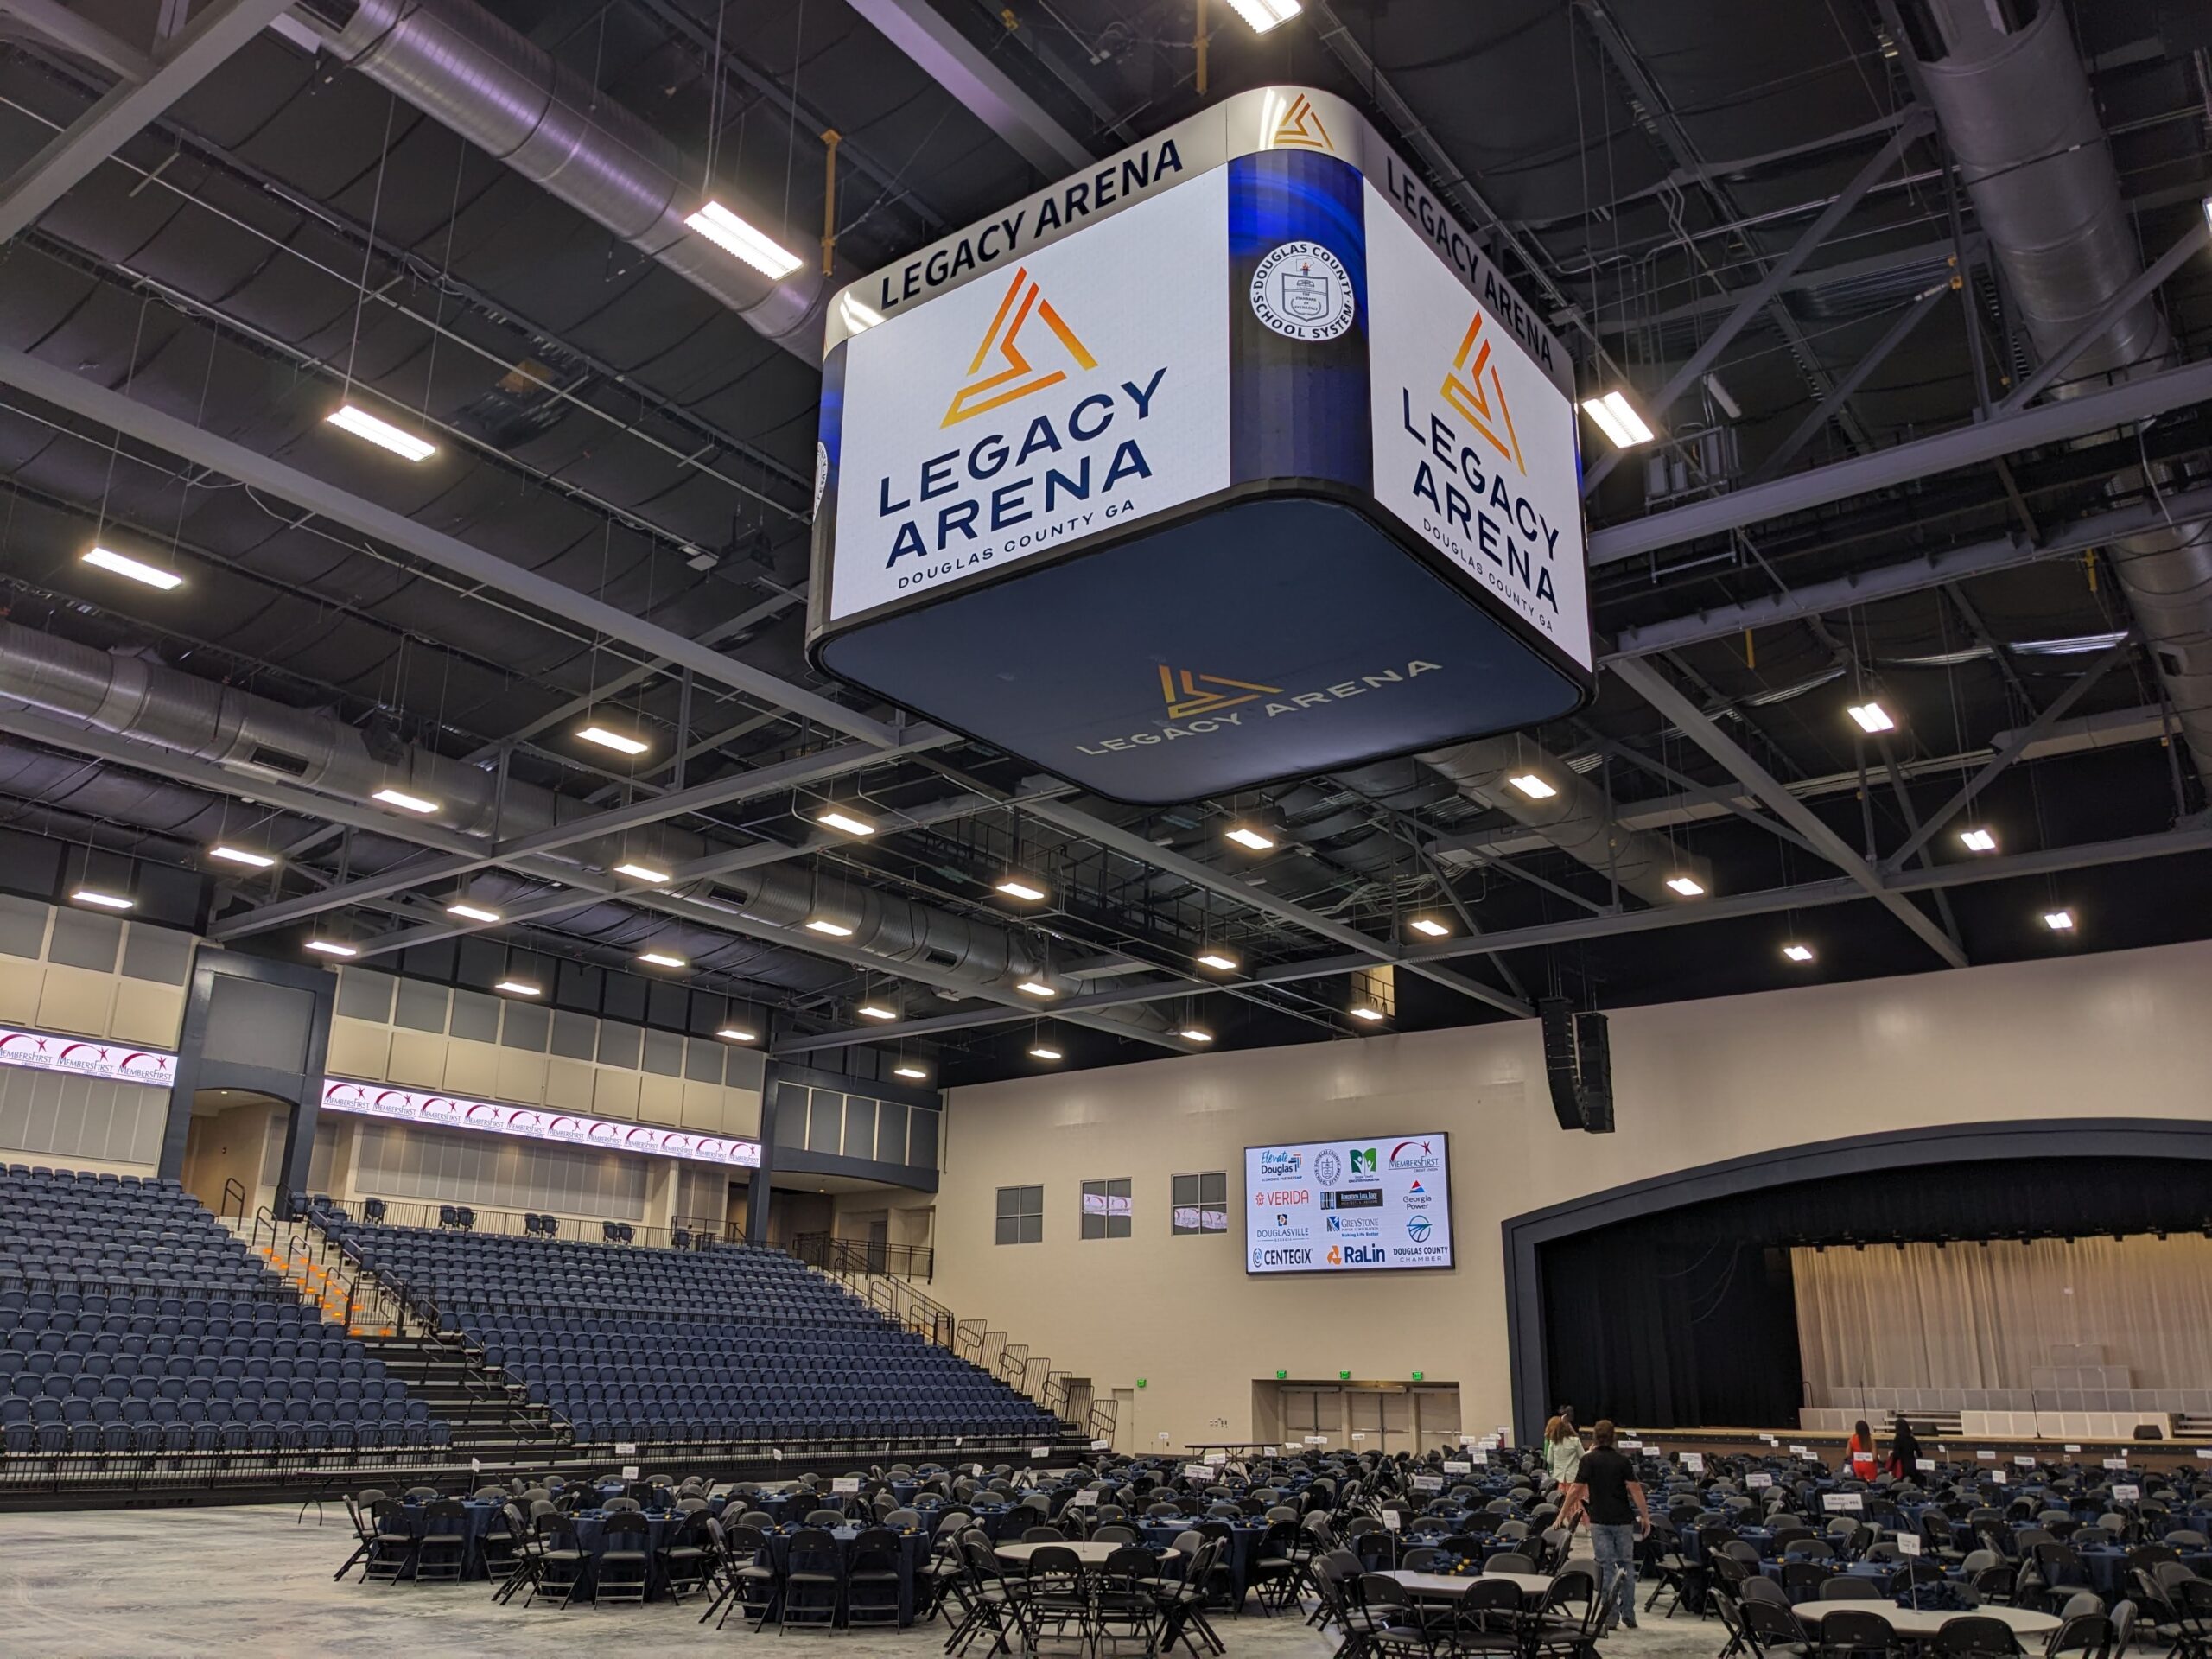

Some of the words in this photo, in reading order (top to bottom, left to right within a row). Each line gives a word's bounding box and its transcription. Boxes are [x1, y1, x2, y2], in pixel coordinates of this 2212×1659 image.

[880, 212, 1026, 311] LEGACY
[1033, 139, 1184, 238] ARENA
[1254, 244, 1307, 289] DOUGLAS
[1312, 247, 1351, 299] COUNTY
[1387, 156, 1478, 284] LEGACY
[1484, 270, 1554, 372] ARENA
[1253, 296, 1306, 337] SCHOOL
[1312, 304, 1352, 338] SYSTEM
[879, 366, 1167, 518] LEGACY
[1403, 386, 1559, 561] LEGACY
[886, 439, 1153, 569] ARENA
[898, 546, 994, 589] DOUGLAS
[1004, 512, 1094, 553] COUNTY
[1105, 499, 1135, 518] GA
[1413, 460, 1559, 614] ARENA
[1423, 518, 1483, 575] DOUGLAS
[1488, 572, 1535, 616] COUNTY
[1539, 614, 1553, 633] GA
[1075, 712, 1243, 755] LEGACY
[1265, 659, 1443, 717] ARENA
[57, 1055, 113, 1072] MEMBERSFIRST
[118, 1065, 173, 1080] MEMBERSFIRST
[1261, 1150, 1288, 1164] Elevate
[1262, 1164, 1293, 1176] Douglas
[1389, 1155, 1439, 1168] MEMBERSFIRST
[1268, 1190, 1309, 1205] VERIDA
[1403, 1195, 1432, 1204] Georgia
[1257, 1228, 1309, 1238] DOUGLASVILLE
[1264, 1249, 1312, 1265] CENTEGIX
[1344, 1243, 1386, 1263] RaLin
[1393, 1247, 1421, 1255] DOUGLAS
